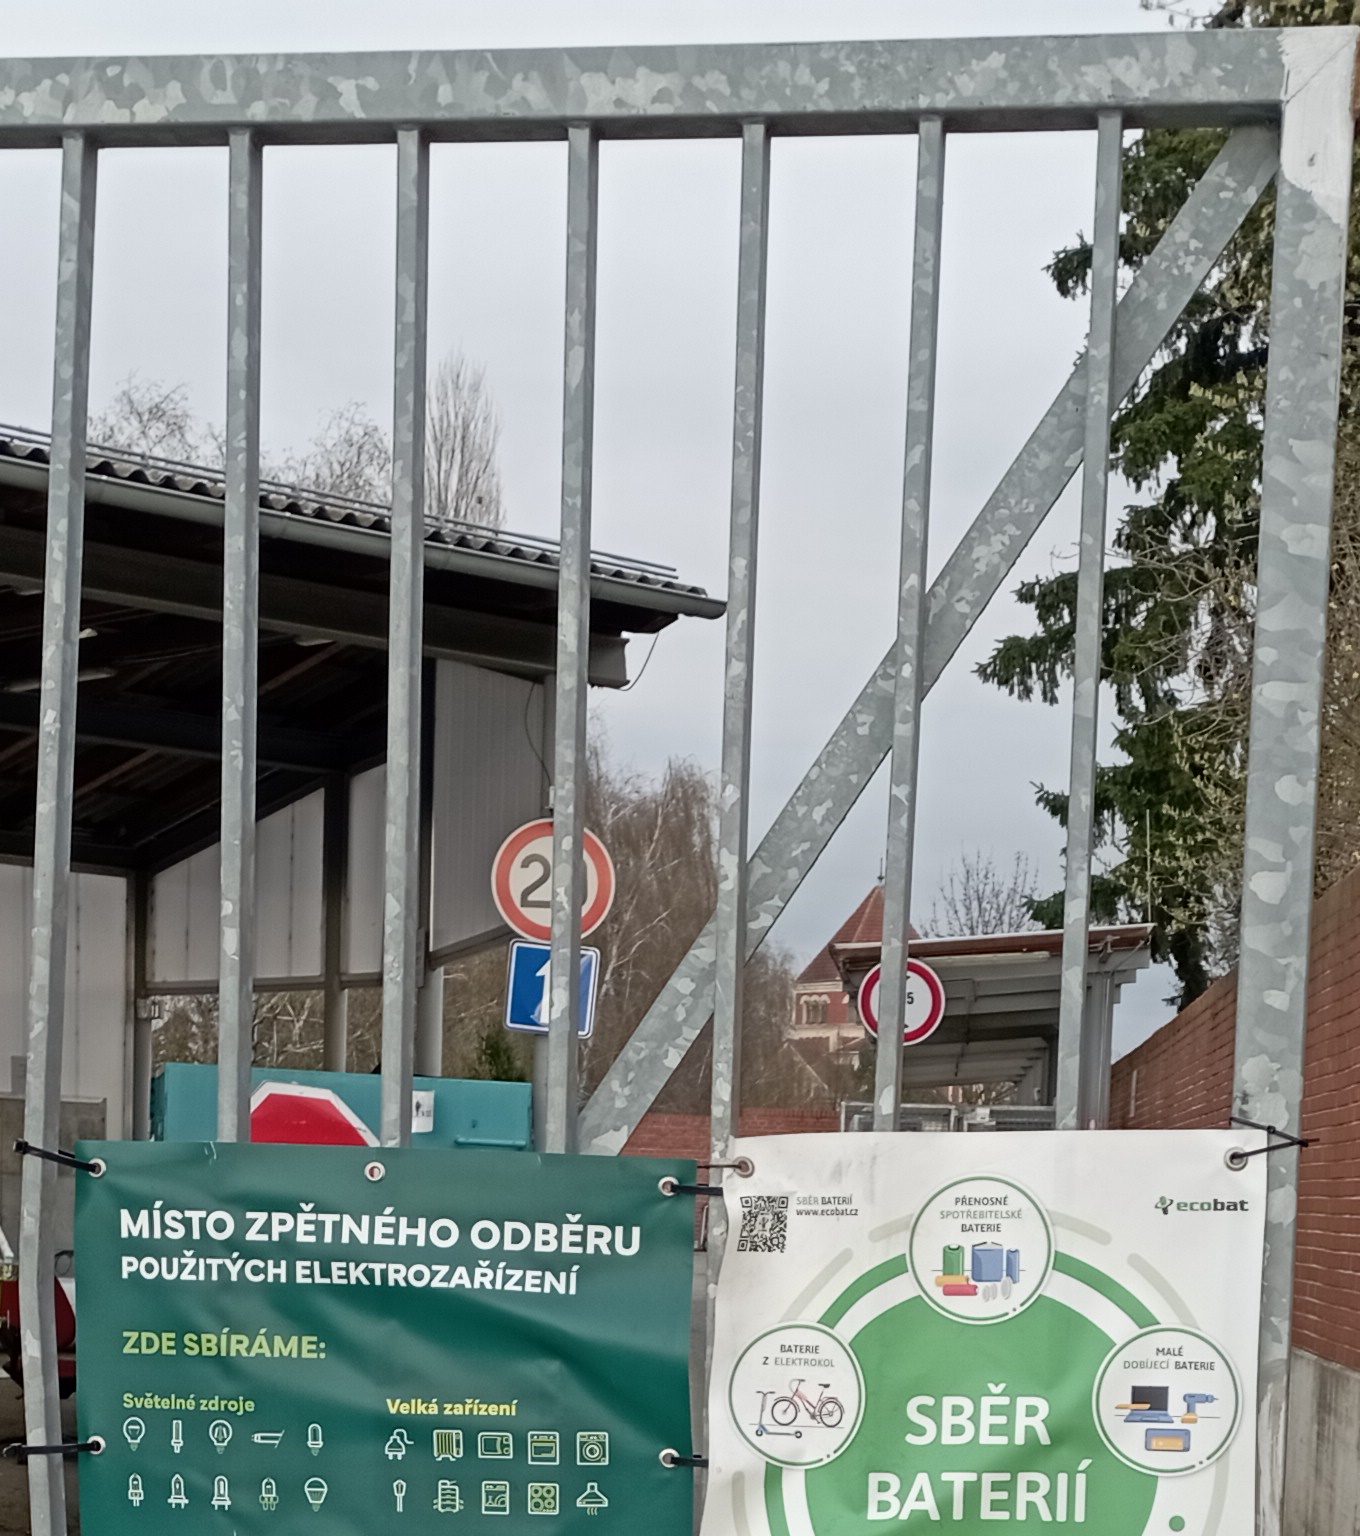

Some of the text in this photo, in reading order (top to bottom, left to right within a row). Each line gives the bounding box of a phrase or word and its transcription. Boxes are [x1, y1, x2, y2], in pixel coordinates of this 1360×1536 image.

[796, 1193, 853, 1206] SBĚR BATERIÍ
[954, 1195, 1008, 1206] PŘENOSNÉ
[1176, 1198, 1249, 1211] ecobat
[795, 1207, 859, 1217] www.ecobat.cz
[940, 1208, 1023, 1219] SPOTŘEBITELSKÉ
[120, 1200, 641, 1256] MÍSTO ZPĚTNÉHO ODBĚRU
[960, 1223, 1002, 1232] BATERIE
[121, 1250, 580, 1295] POUŽITÝCH ELEKTROZAŘÍZENÍ
[122, 1327, 327, 1359] ZDE SBÍRÁME:
[780, 1344, 820, 1354] BATERIE
[1155, 1345, 1184, 1357] MALÉ
[762, 1356, 836, 1367] Z ELEKTROKOL
[1123, 1358, 1216, 1371] DOBÍJECÍ BATERIE
[123, 1392, 256, 1416] Světelné zdroje
[386, 1398, 518, 1417] Velká zařízení
[905, 1382, 1052, 1446] SBĚR
[867, 1458, 1093, 1523] BATERIÍ
